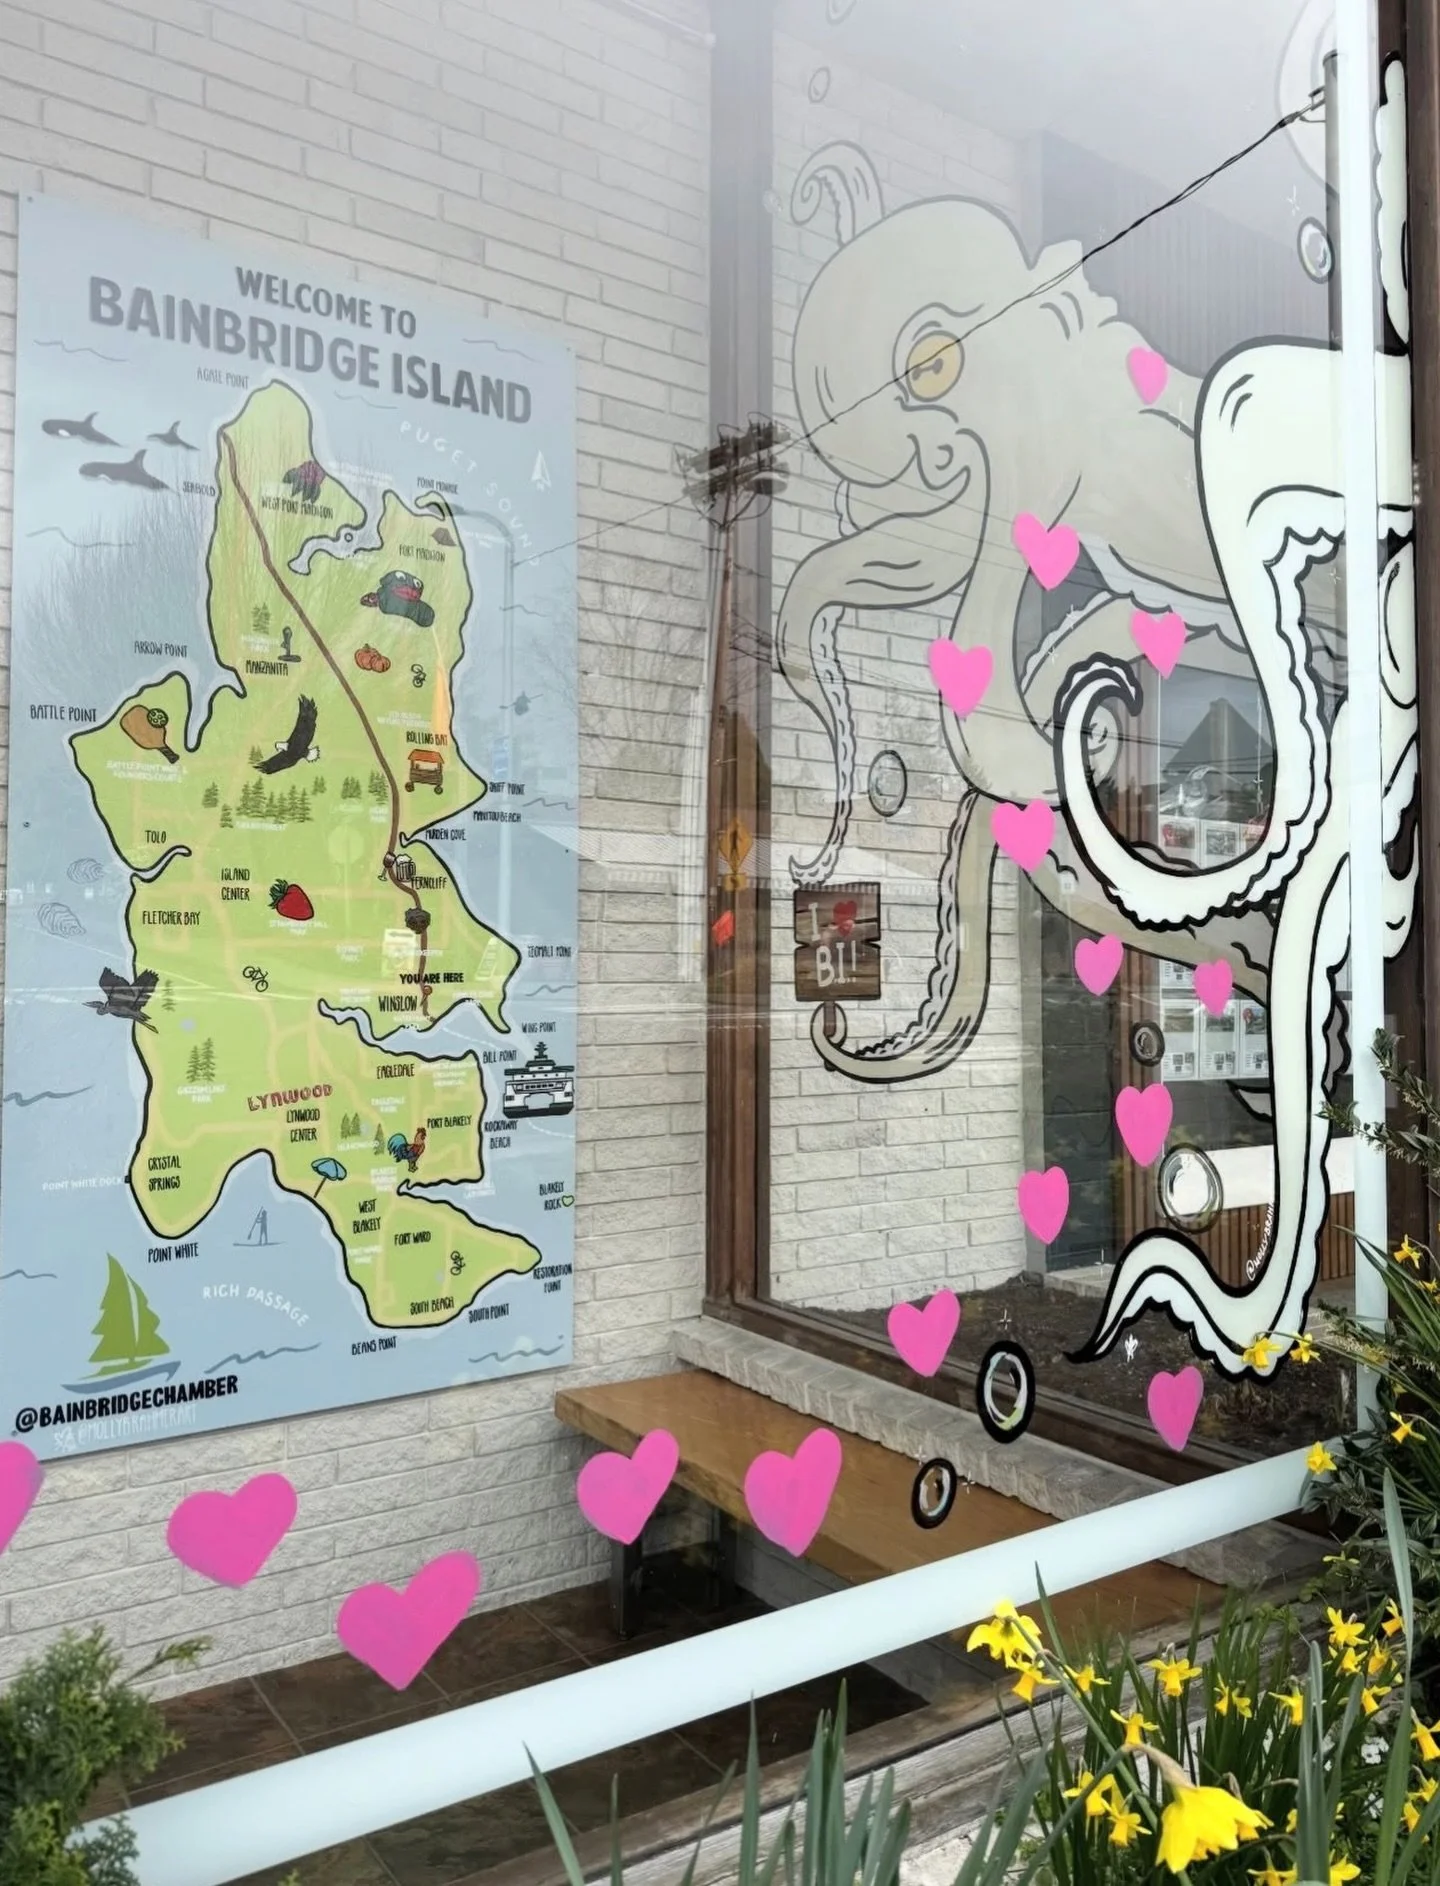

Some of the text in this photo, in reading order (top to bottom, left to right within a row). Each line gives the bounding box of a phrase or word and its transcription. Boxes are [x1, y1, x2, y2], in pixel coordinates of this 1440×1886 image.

[236, 266, 417, 339] WELCOME TO
[89, 276, 532, 424] BAINBRIDGE ISLAND
[196, 367, 249, 390] AGATE POINT
[400, 420, 478, 473] PUGET
[417, 476, 435, 489] POINT
[261, 496, 281, 511] WEST
[134, 640, 188, 659] ARROW POINT
[245, 659, 289, 677] MANZANITA
[29, 704, 97, 722] BATTLE POINT
[406, 730, 448, 746] ROLLING BAY
[473, 810, 522, 823] MANITOU BEACH
[144, 830, 167, 844] TOLO
[425, 828, 467, 841] MURDEN COVE
[221, 867, 251, 882] ISLAND
[411, 875, 448, 890] FERNCLIFF
[221, 886, 251, 902] CENTER
[142, 910, 201, 926] FLETCHER BAY
[808, 902, 821, 941] I
[399, 972, 465, 985] YOU ARE HERE
[378, 995, 418, 1013] WINSLOW
[521, 1021, 557, 1034] WING POINT
[482, 1050, 518, 1064] BILL POINT
[376, 1063, 416, 1080] EAGLEDALE
[286, 1108, 321, 1124] LYNWOOD
[427, 1115, 473, 1129] PORT BLAKELY
[483, 1119, 519, 1132] ROCKAWAY
[290, 1127, 317, 1143] CENTER
[489, 1136, 512, 1150] BEACH
[147, 1155, 182, 1171] CRYSTAL
[148, 1175, 181, 1192] SPRINGS
[538, 1181, 565, 1196] BLAKELY
[358, 1198, 378, 1214] WEST
[544, 1198, 562, 1212] ROCK
[352, 1216, 382, 1235] BLAKELY
[394, 1230, 432, 1247] FORT WARD
[147, 1242, 200, 1264] POINT WHITE
[532, 1263, 573, 1280] RESTORATION
[544, 1279, 562, 1294] POINT
[202, 1283, 310, 1328] RICH PASSAGE
[410, 1296, 455, 1316] SOUTH BEACH
[468, 1303, 510, 1324] SOUTH POINT
[351, 1335, 397, 1356] BEANS POINT
[15, 1374, 239, 1434] @BAINBRIDGECHAMBER
